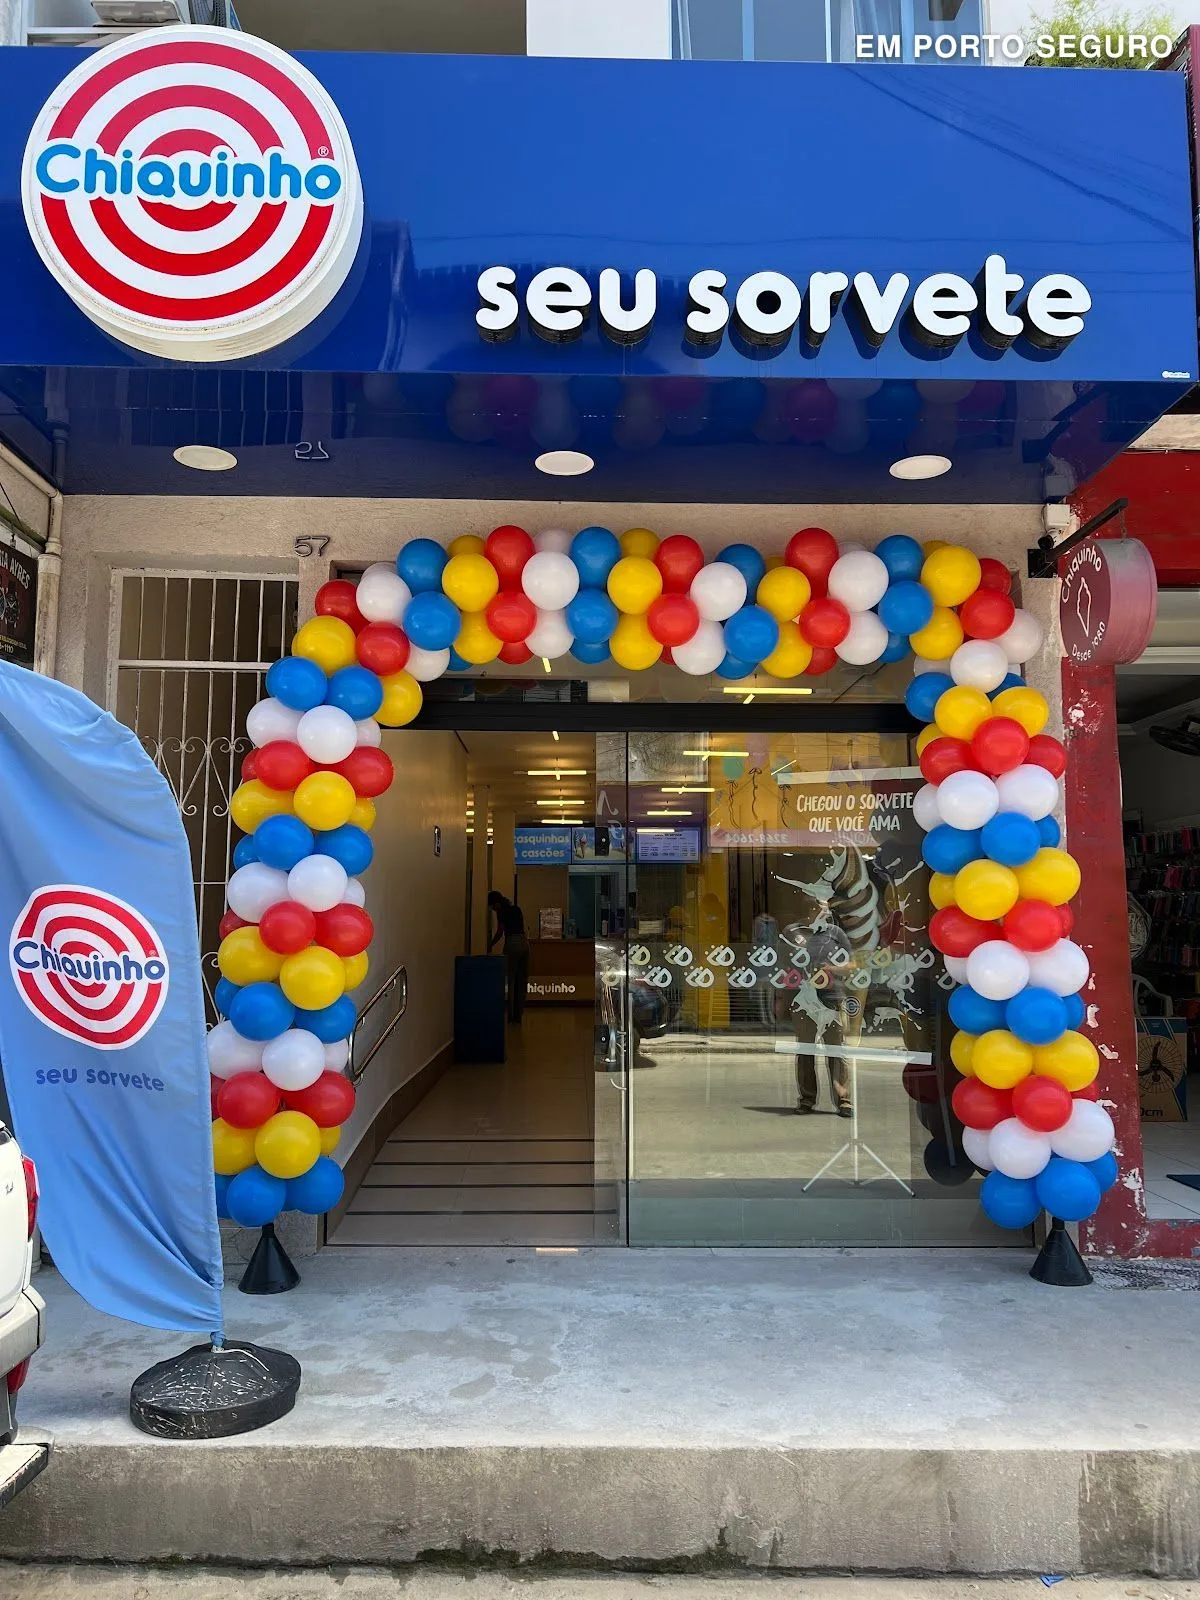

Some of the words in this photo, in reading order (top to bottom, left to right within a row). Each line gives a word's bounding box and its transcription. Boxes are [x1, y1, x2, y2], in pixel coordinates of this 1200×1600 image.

[36, 144, 341, 199] Chiquinho
[475, 266, 658, 332] seu
[686, 254, 1092, 338] sorvete
[294, 536, 331, 557] 57
[9, 557, 30, 590] AYRES
[1061, 544, 1102, 604] Chiquinho
[1072, 643, 1092, 661] Desde
[796, 794, 842, 812] CHEGOU
[845, 794, 856, 810] O
[859, 792, 914, 812] SORVETE
[808, 816, 832, 832] QUE
[835, 811, 864, 832] VOCÊ
[868, 814, 900, 831] AMA
[521, 847, 565, 858] cascões
[12, 940, 166, 982] Chiquinho
[35, 1068, 78, 1085] seu
[86, 1068, 165, 1091] sorvete
